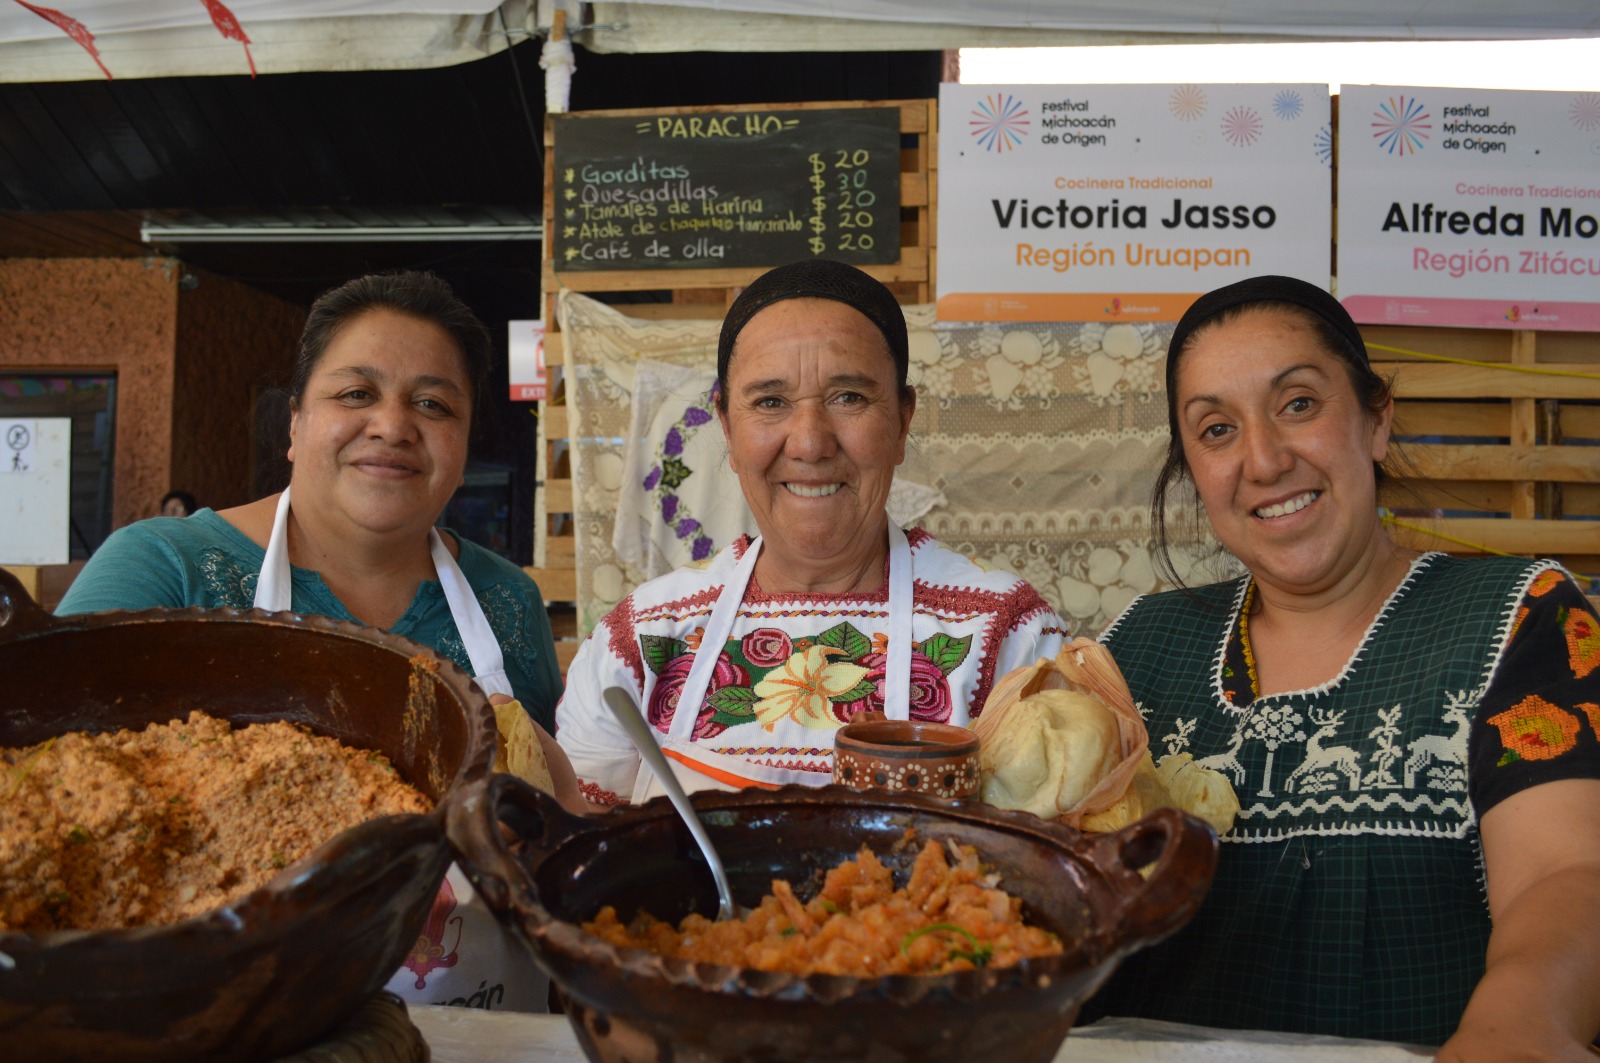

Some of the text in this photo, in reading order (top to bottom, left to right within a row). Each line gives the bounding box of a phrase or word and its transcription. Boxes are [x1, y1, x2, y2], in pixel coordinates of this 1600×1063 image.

[1041, 99, 1089, 114] Festival
[1443, 104, 1490, 119] Festival
[1042, 113, 1117, 129] Michoacán
[1443, 119, 1516, 136] Michoacán
[1042, 131, 1107, 147] de Origen
[1443, 137, 1507, 154] de Origen
[581, 155, 690, 185] Gorditas
[834, 149, 870, 168] 20
[581, 179, 720, 205] Quesadillas
[837, 169, 868, 191] 30
[1055, 176, 1213, 190] Cocinera Tradicional
[1455, 182, 1525, 198] Cocinera
[579, 200, 659, 221] Tamales
[667, 199, 692, 216] de
[837, 190, 876, 211] 20
[991, 198, 1277, 230] Victoria Jasso
[579, 221, 624, 240] Atole
[631, 219, 656, 236] de
[838, 211, 873, 229] 20
[1381, 201, 1599, 239] Alfreda Mo
[580, 241, 633, 261] Café
[644, 239, 672, 258] de
[682, 237, 726, 259] olla
[838, 233, 874, 251] 20
[1016, 241, 1251, 273] Región Uruapan
[1413, 247, 1510, 279] Región
